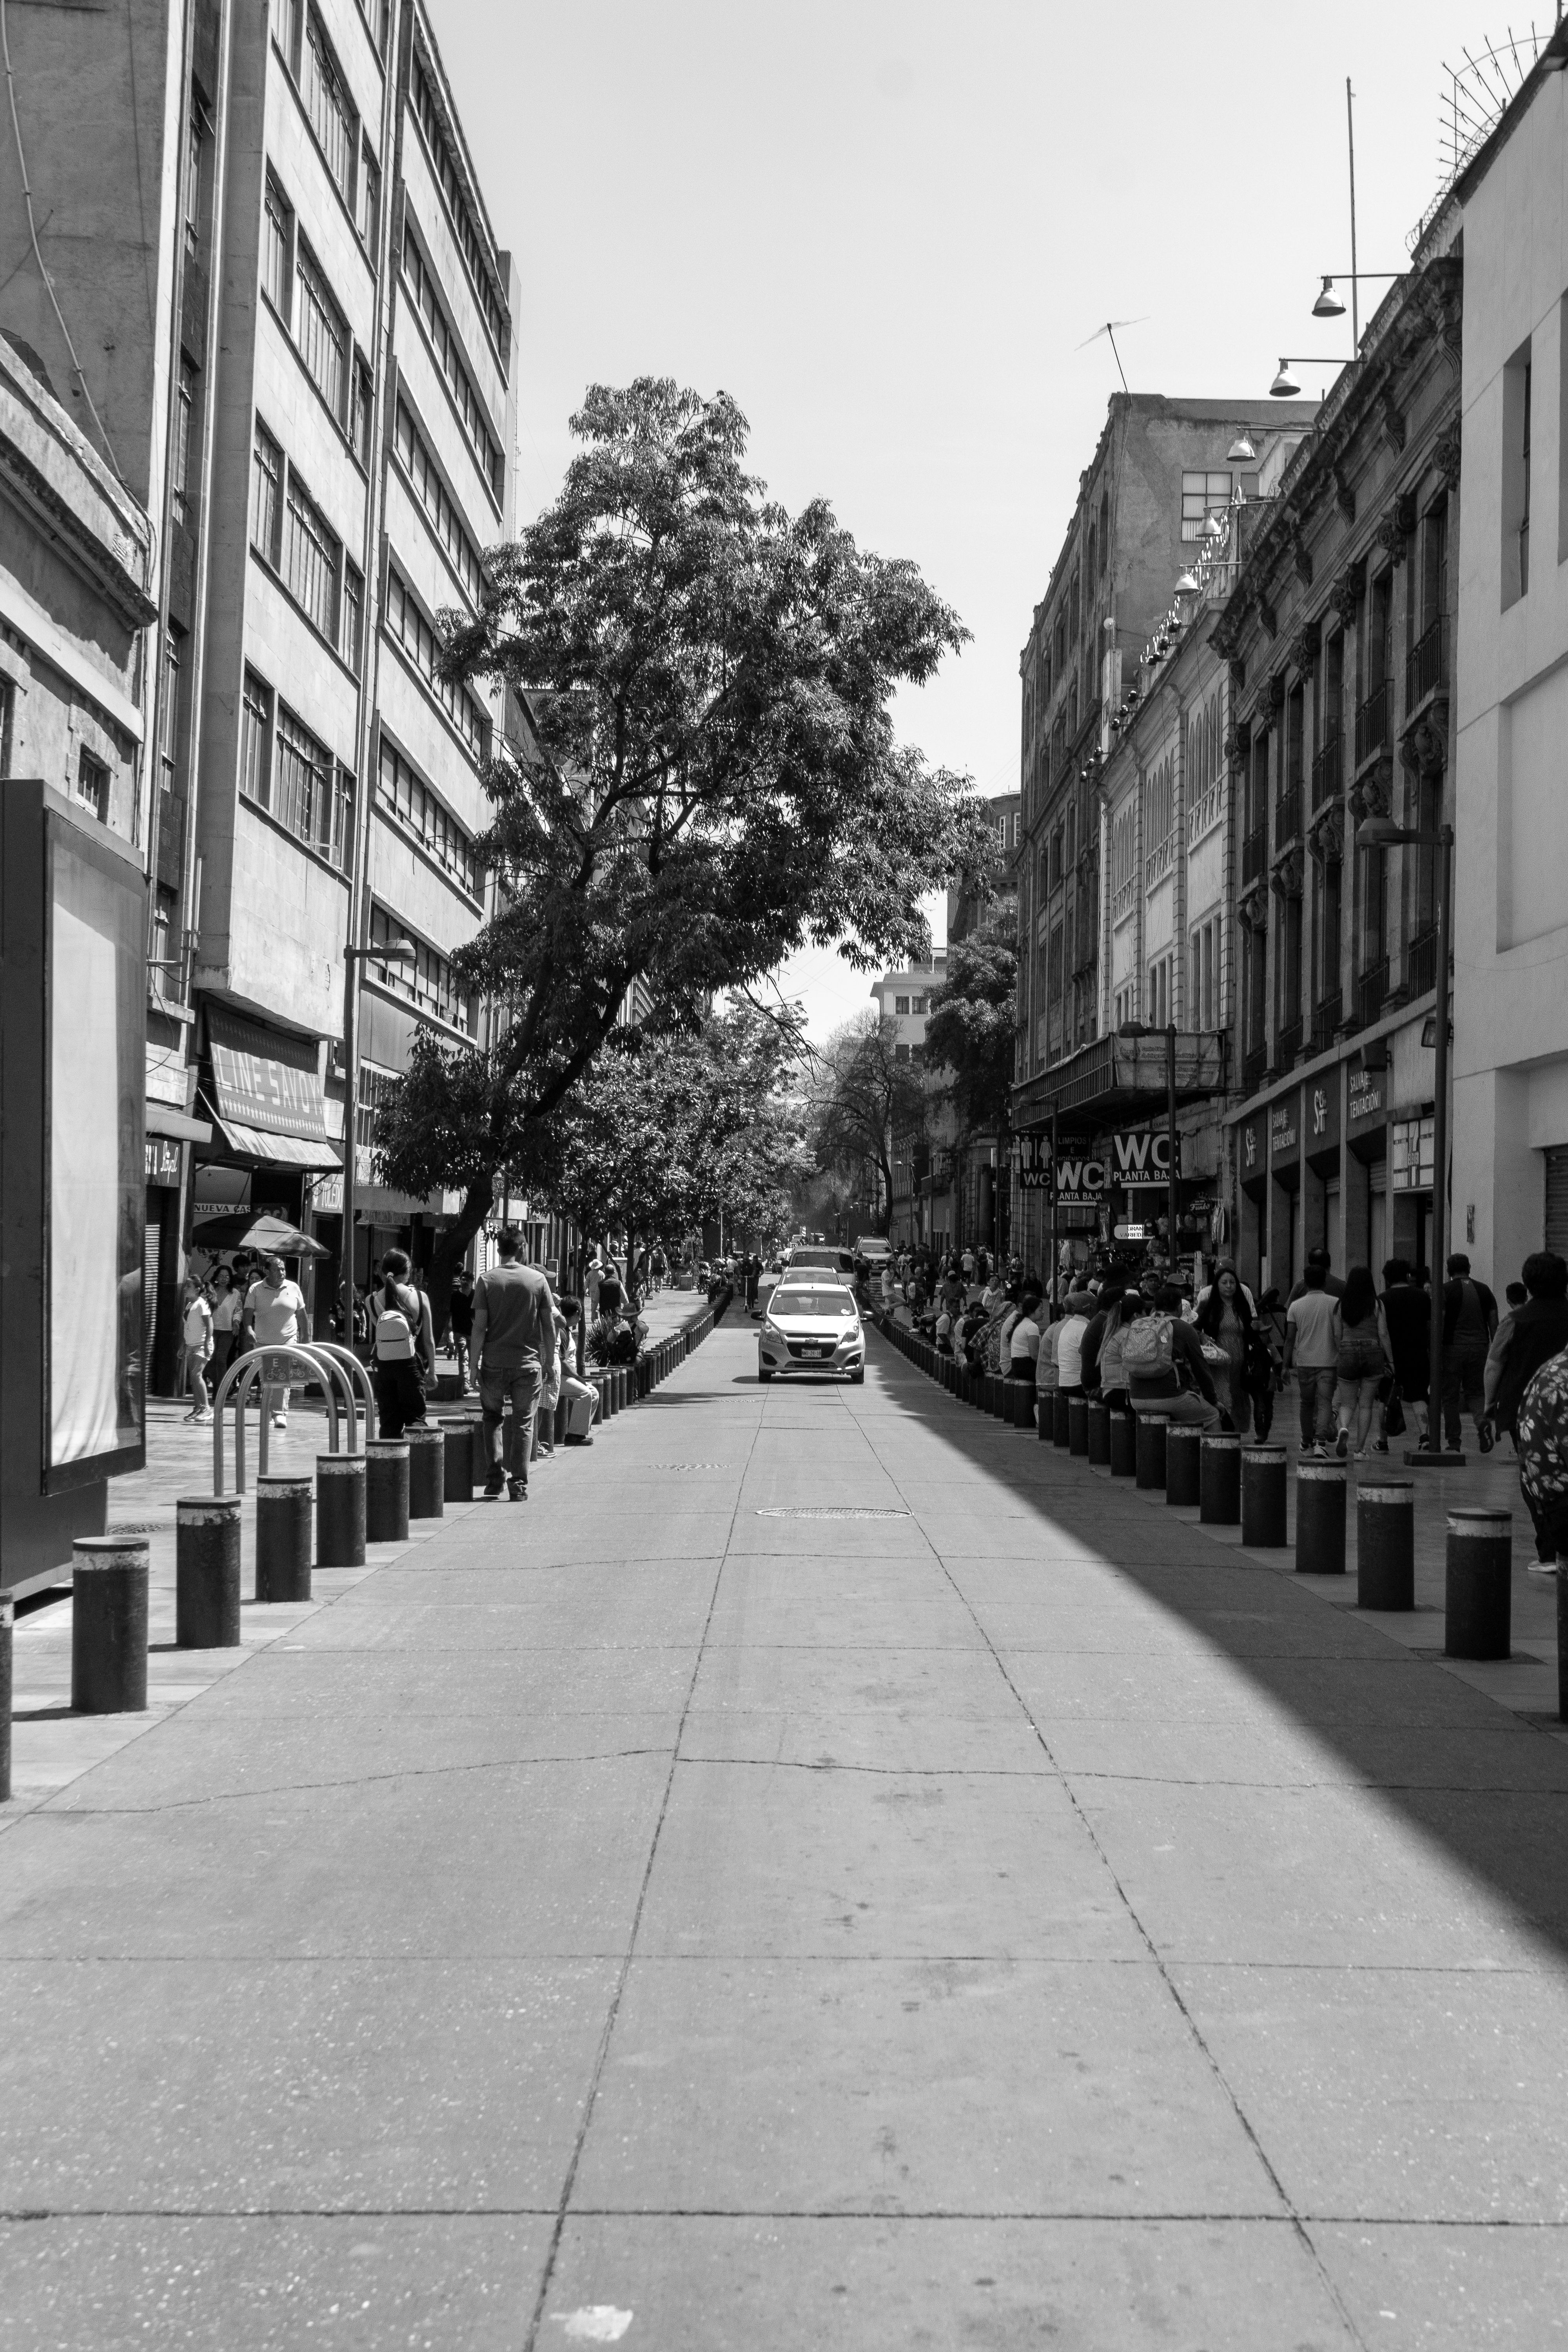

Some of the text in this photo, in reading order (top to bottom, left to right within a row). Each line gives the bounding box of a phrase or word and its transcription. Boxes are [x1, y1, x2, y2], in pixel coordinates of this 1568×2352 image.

[216, 1044, 318, 1115] CINE SAVOY
[1350, 1071, 1371, 1093] SALVAJE
[1350, 1089, 1380, 1119] TENTACIÓN
[1114, 1133, 1179, 1170] WC
[1023, 1172, 1051, 1186] WC
[1051, 1161, 1105, 1190] WC
[1114, 1169, 1181, 1181] PLANTA BAA
[321, 1182, 343, 1209] TOLEDO
[1050, 1192, 1102, 1200] PANTA BAJA
[195, 1204, 230, 1212] NUEVA
[1189, 1203, 1210, 1211] Funko
[273, 1358, 279, 1367] E
